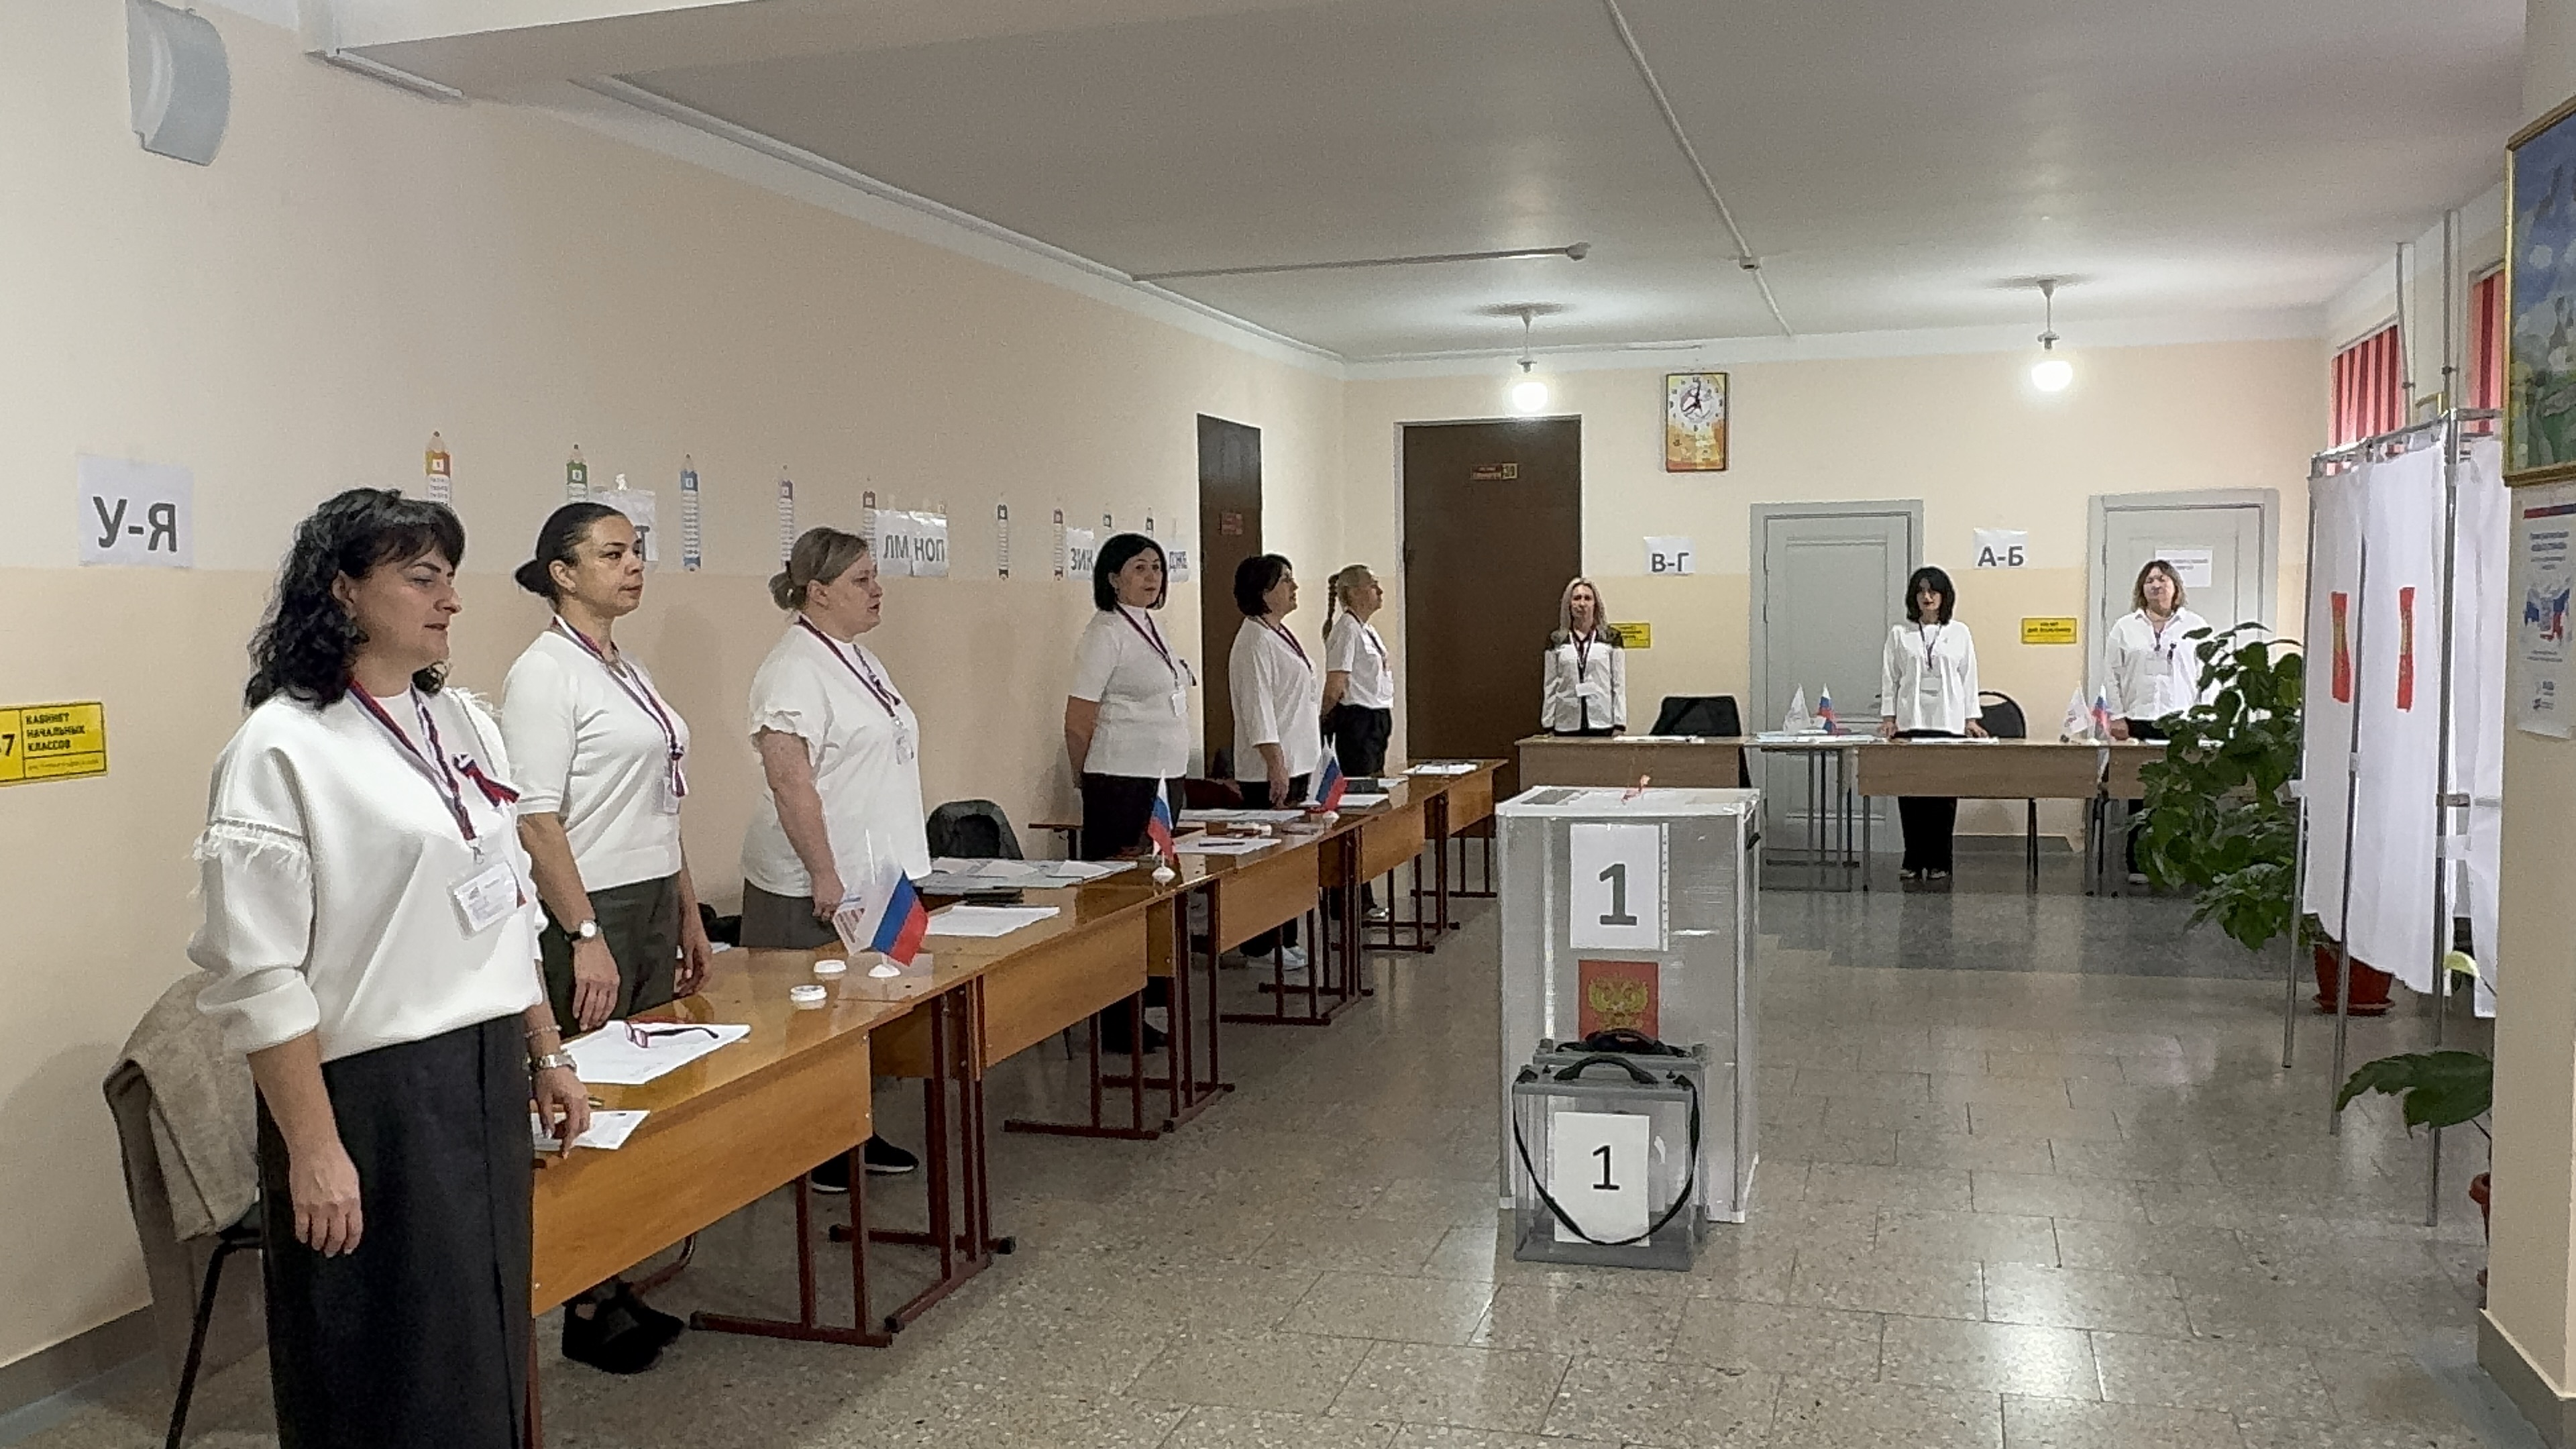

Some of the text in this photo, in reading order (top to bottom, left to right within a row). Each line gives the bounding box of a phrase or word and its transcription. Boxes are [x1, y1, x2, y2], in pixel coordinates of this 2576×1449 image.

[93, 496, 177, 552] У-Я
[883, 535, 909, 559] ЛМ
[913, 537, 945, 563] НОП
[1071, 548, 1093, 571] ЗИК
[1978, 545, 2024, 567] А-Б
[1651, 552, 1690, 572] В-Г
[1599, 863, 1638, 926] 1
[1593, 1144, 1620, 1191] 1
